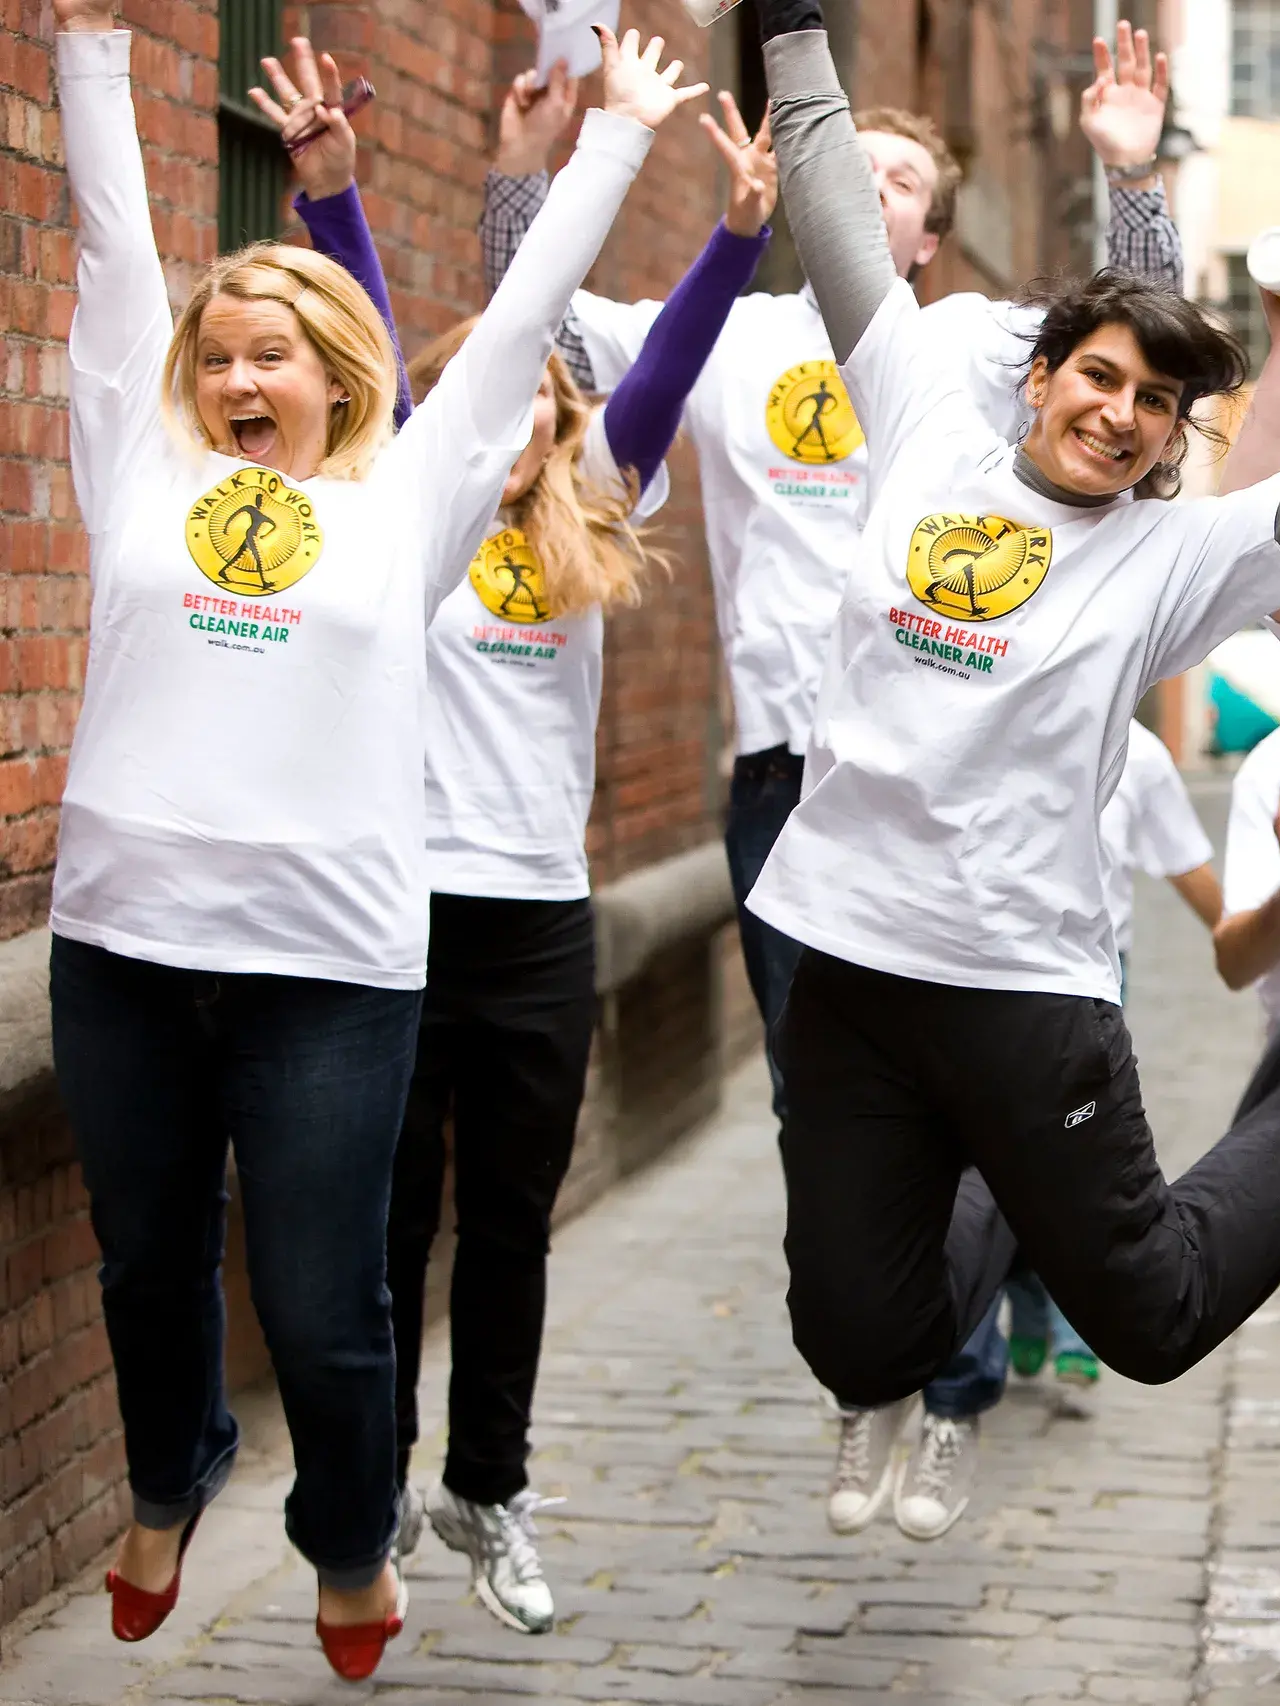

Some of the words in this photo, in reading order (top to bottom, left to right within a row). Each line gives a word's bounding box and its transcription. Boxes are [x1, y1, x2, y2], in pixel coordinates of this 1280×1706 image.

[190, 474, 245, 521] WALK
[257, 471, 278, 494] TO
[285, 493, 320, 543] WORK
[919, 514, 988, 536] WALK
[182, 593, 236, 614] BETTER
[241, 603, 302, 625] HEALTH
[189, 613, 258, 639] CLEANER
[261, 626, 289, 643] AIR
[889, 607, 942, 639] BETTER
[944, 626, 1010, 657] HEALTH
[207, 638, 265, 654] walk.com.au
[895, 628, 963, 663] CLEANER
[965, 651, 994, 674] AIR
[914, 655, 971, 681] walk.com.au
